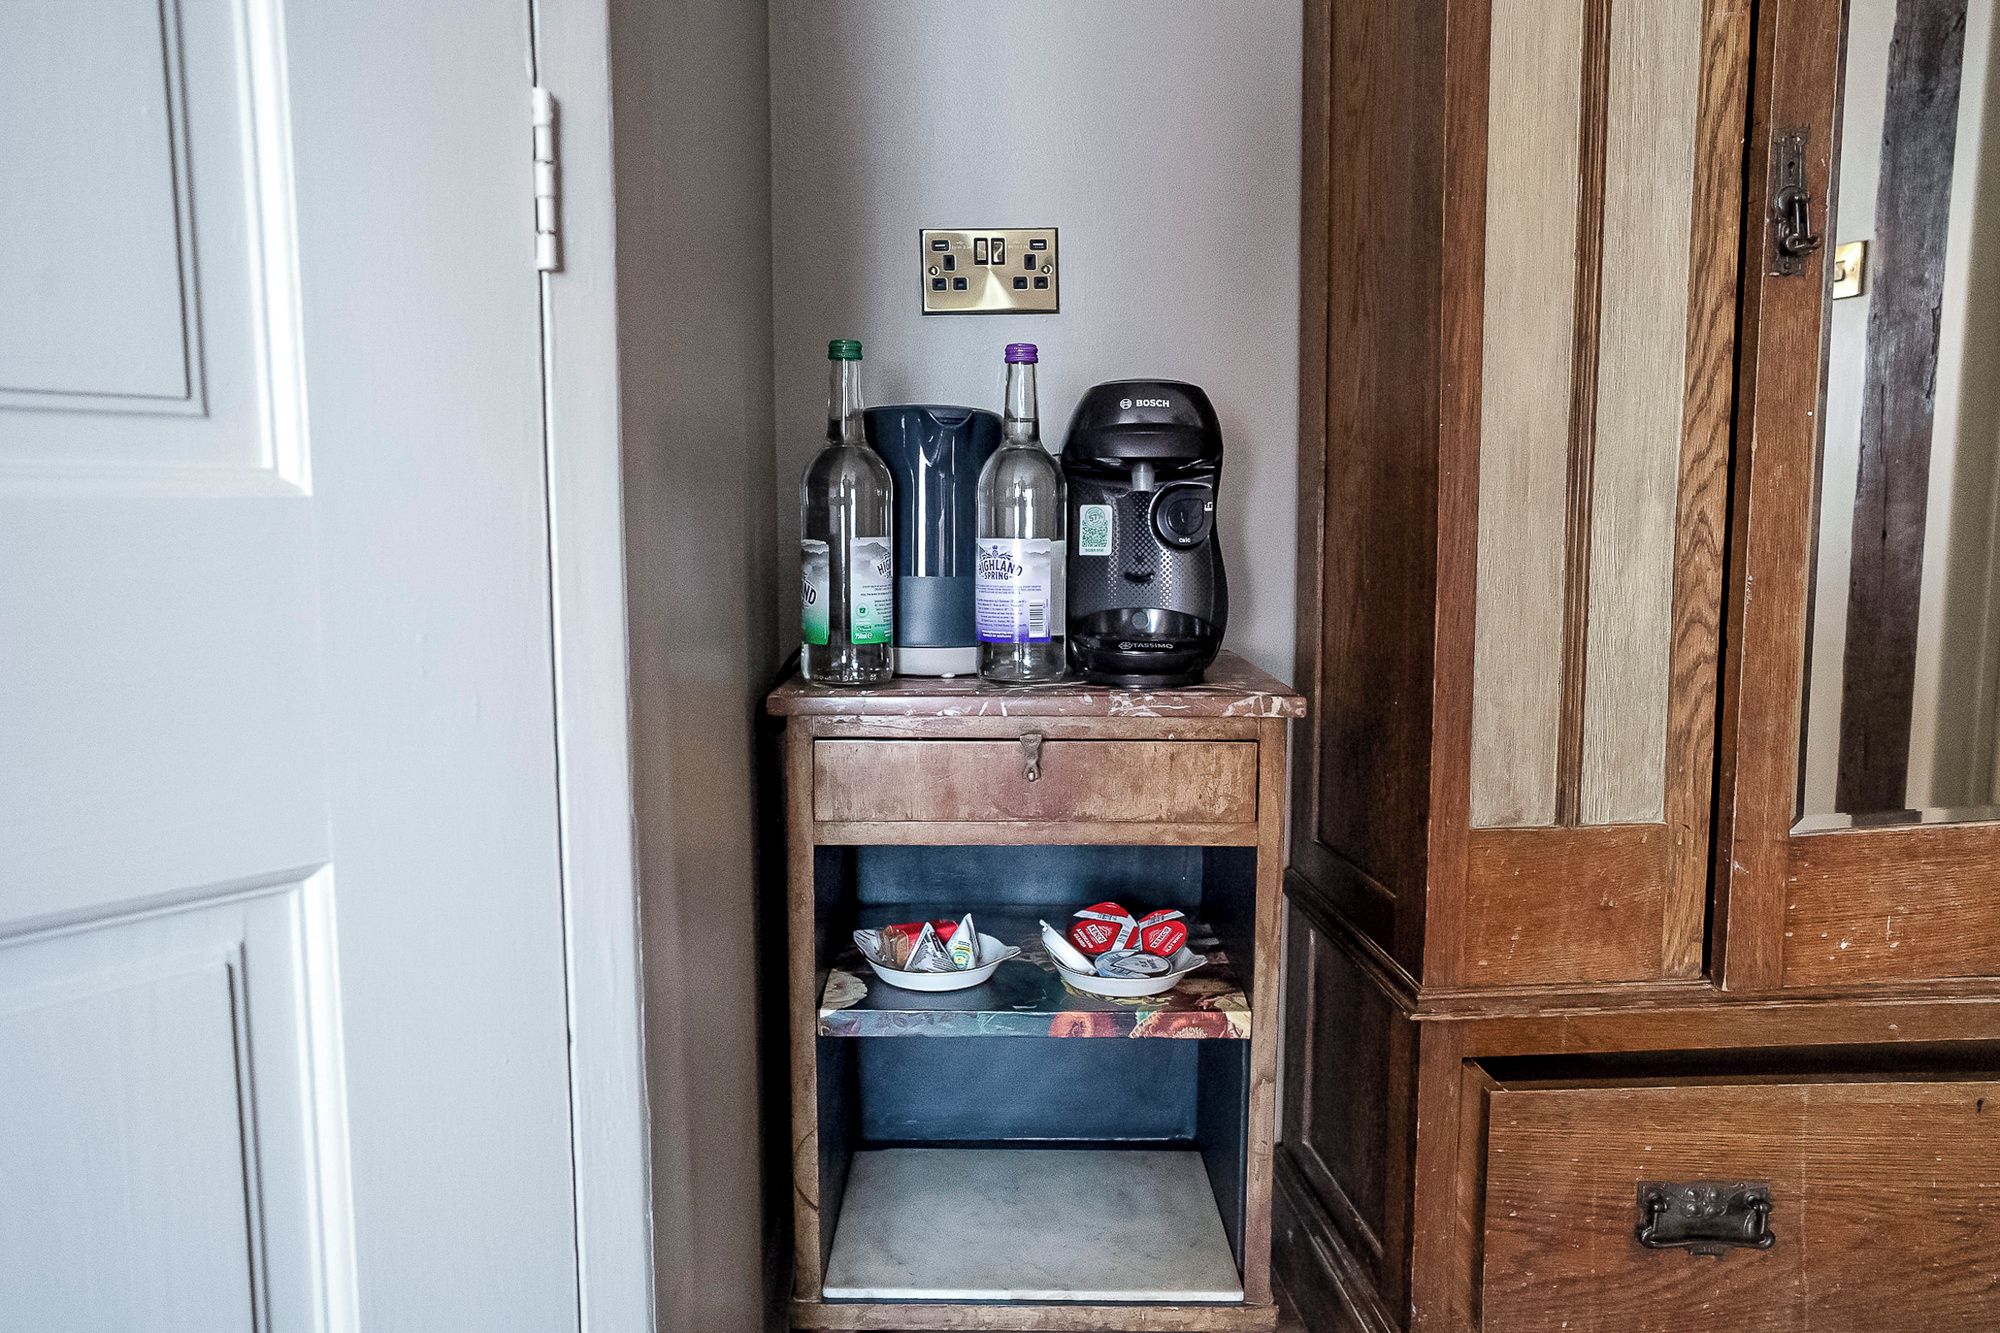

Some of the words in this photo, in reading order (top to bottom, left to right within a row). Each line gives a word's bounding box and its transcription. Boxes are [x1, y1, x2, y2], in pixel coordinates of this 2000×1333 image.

[1136, 399, 1170, 408] BOSCH
[984, 571, 1009, 580] SPRING
[1088, 924, 1106, 942] KENCO
[1151, 927, 1171, 947] KENCO
